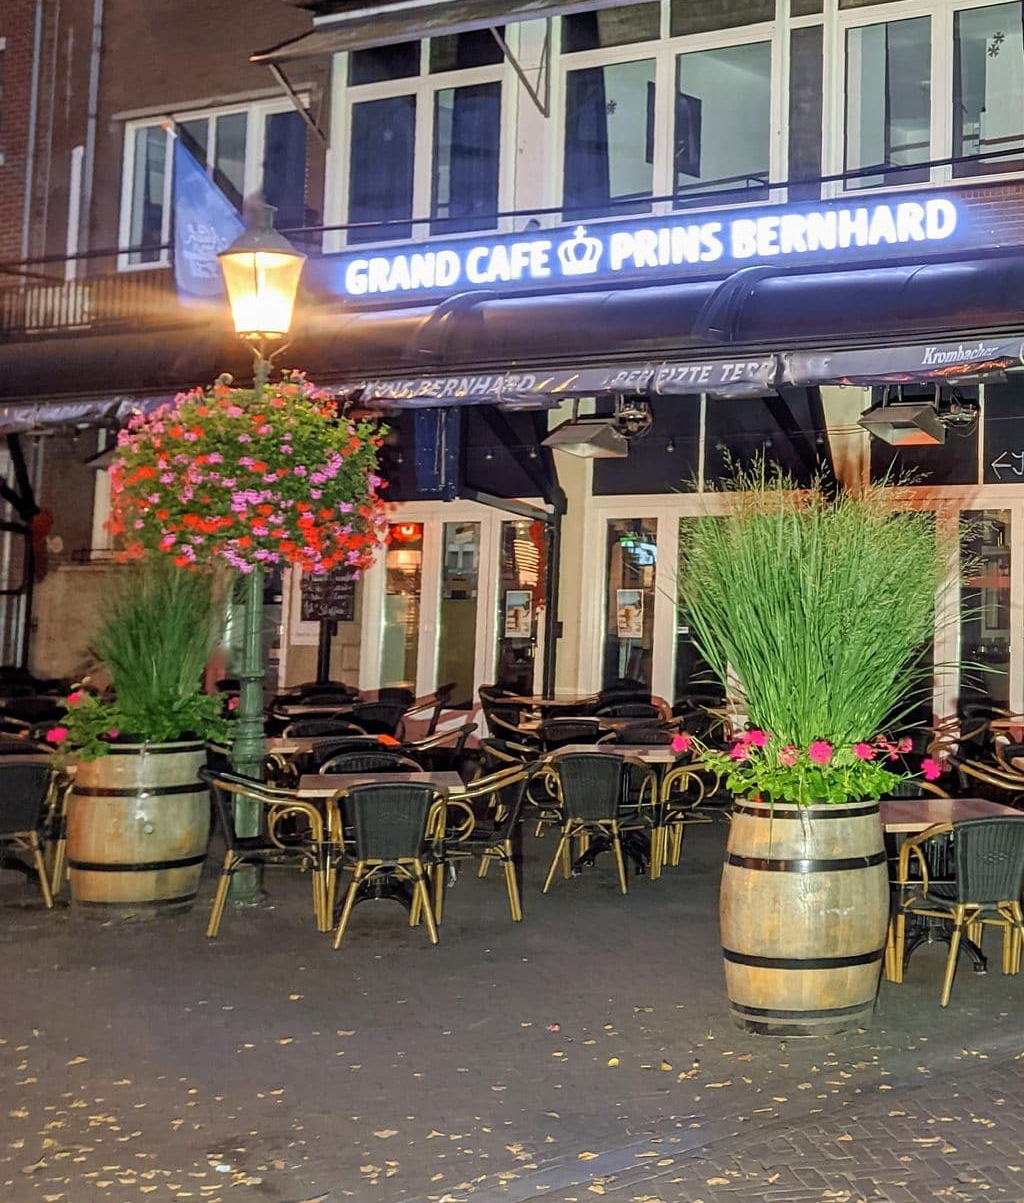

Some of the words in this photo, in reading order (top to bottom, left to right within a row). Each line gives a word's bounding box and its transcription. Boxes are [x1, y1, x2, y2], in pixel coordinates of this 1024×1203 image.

[345, 250, 461, 295] GRAND
[466, 241, 552, 284] CAFE
[610, 222, 722, 270] PRINS
[731, 199, 957, 259] BERNHARD
